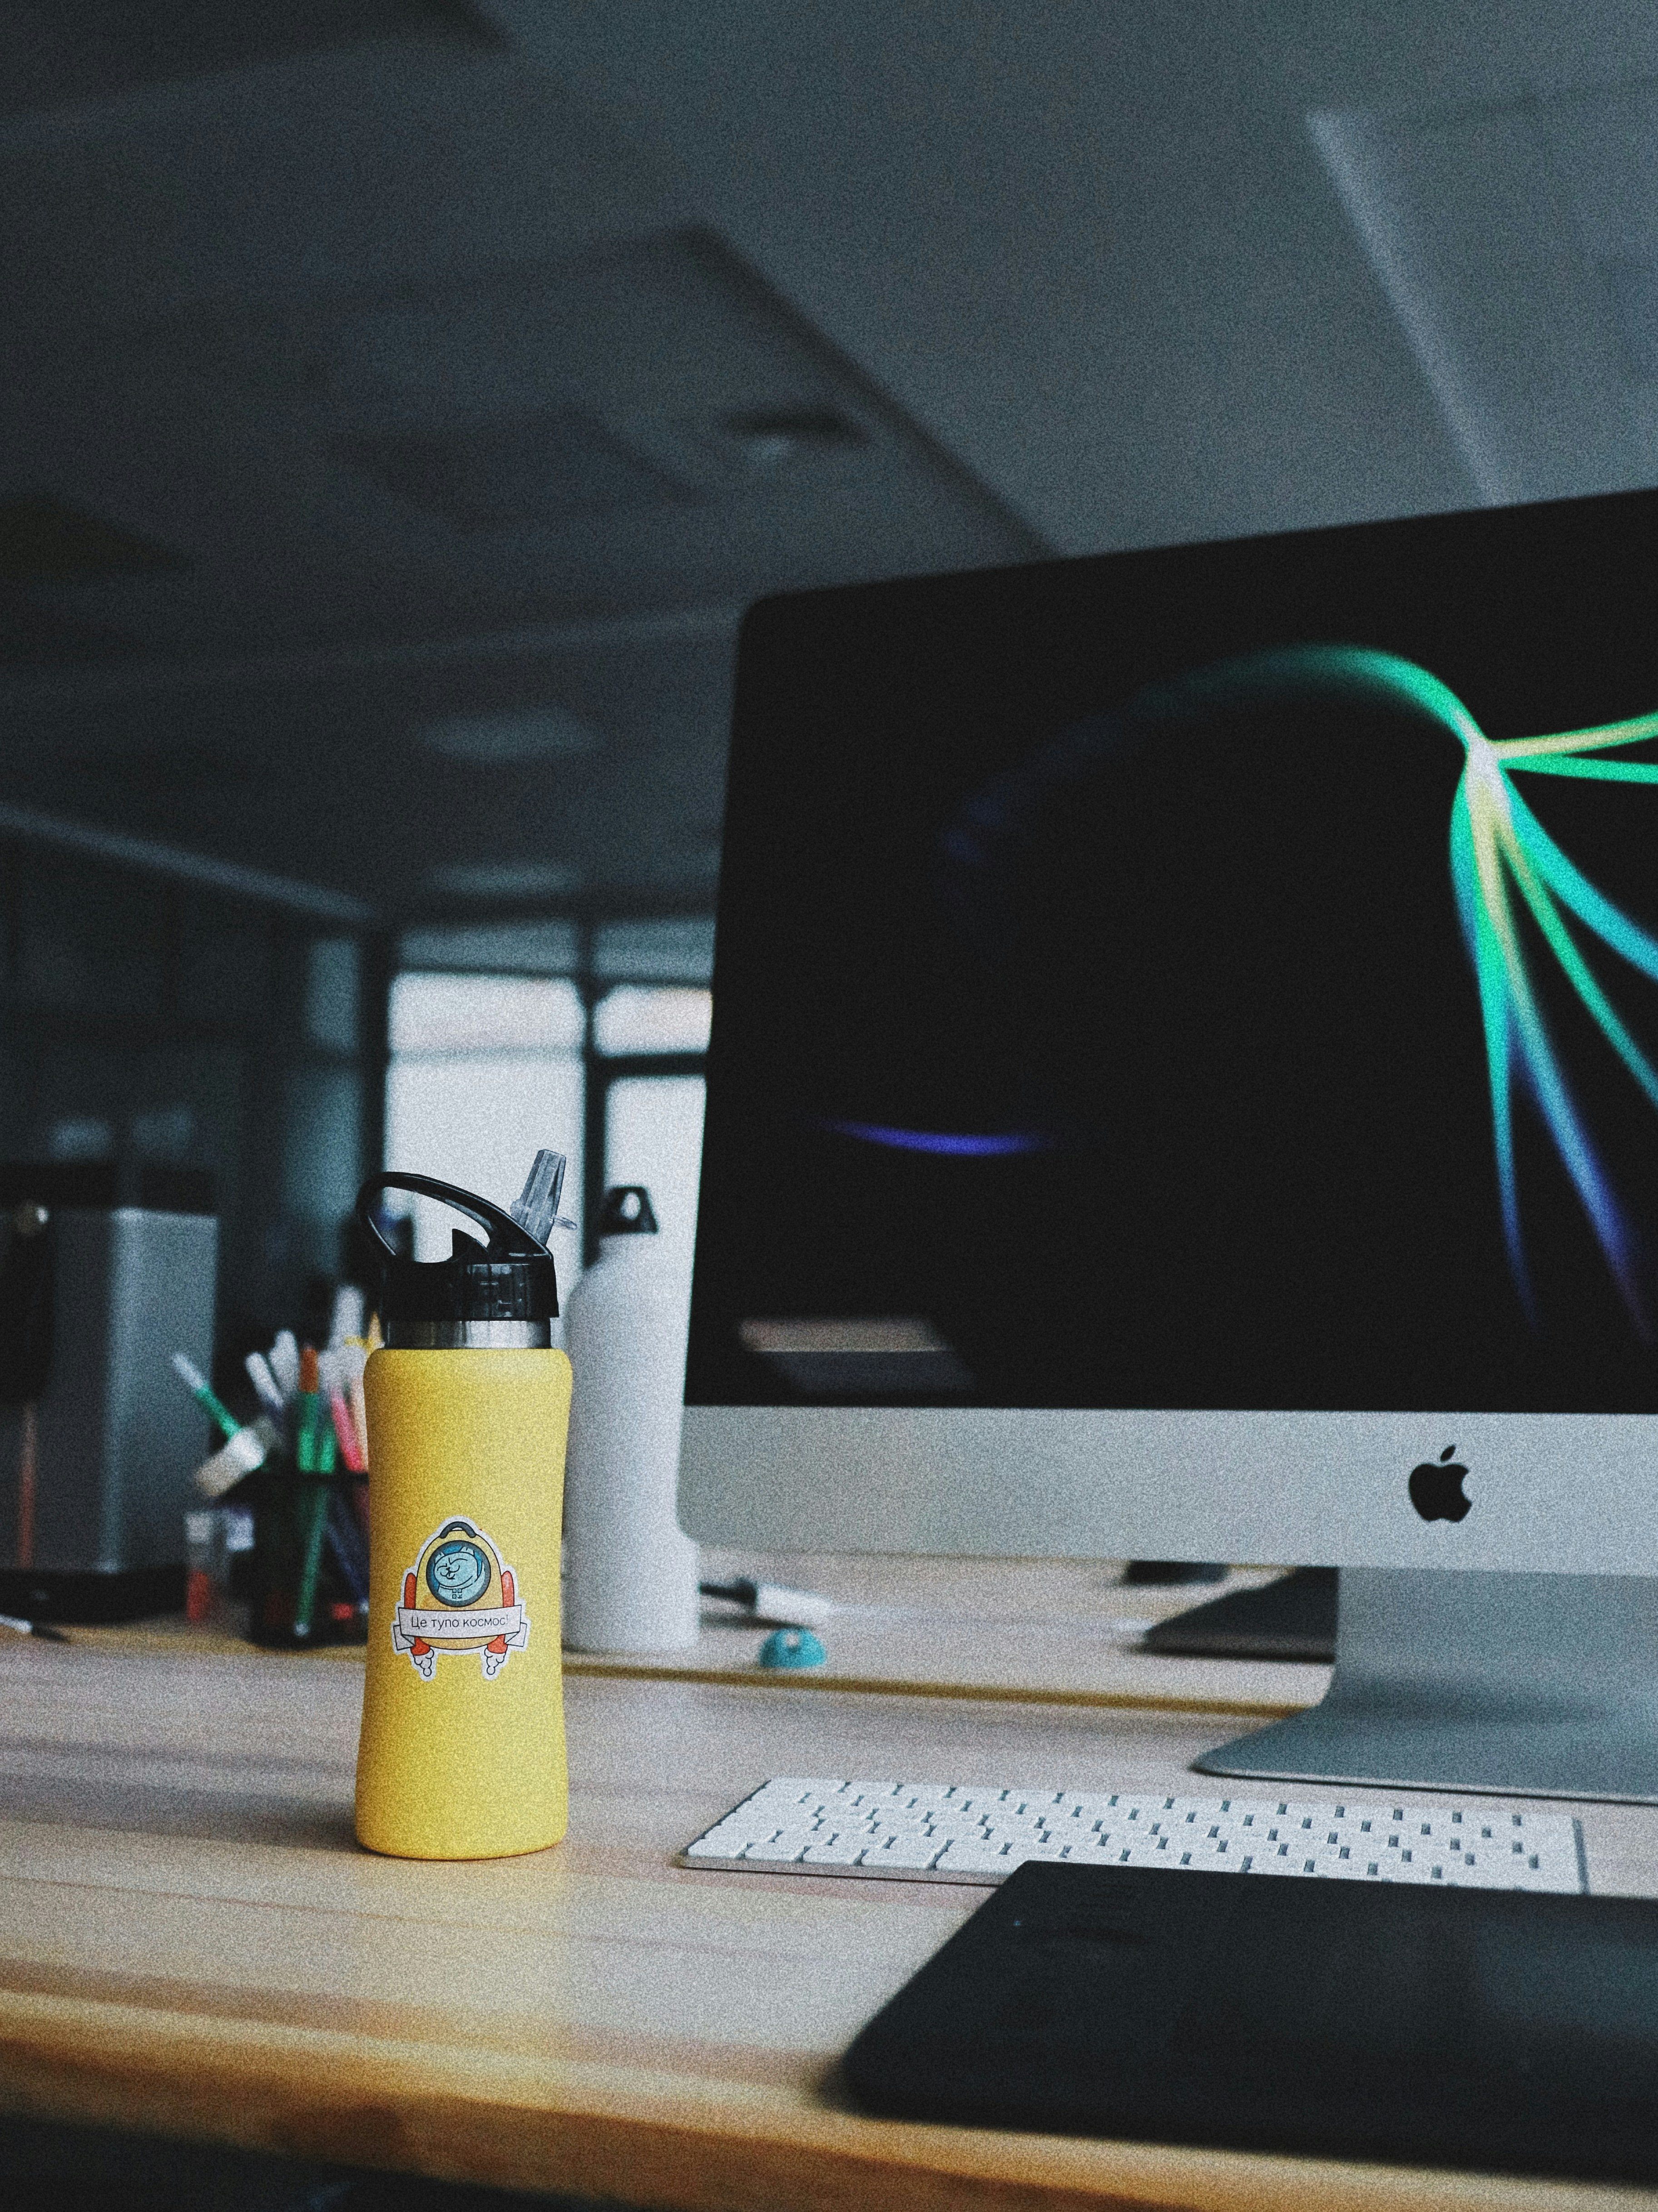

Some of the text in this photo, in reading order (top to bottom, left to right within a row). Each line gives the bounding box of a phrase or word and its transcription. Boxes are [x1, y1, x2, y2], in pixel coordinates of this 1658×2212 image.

[411, 1614, 509, 1631] Це тупо космос!
